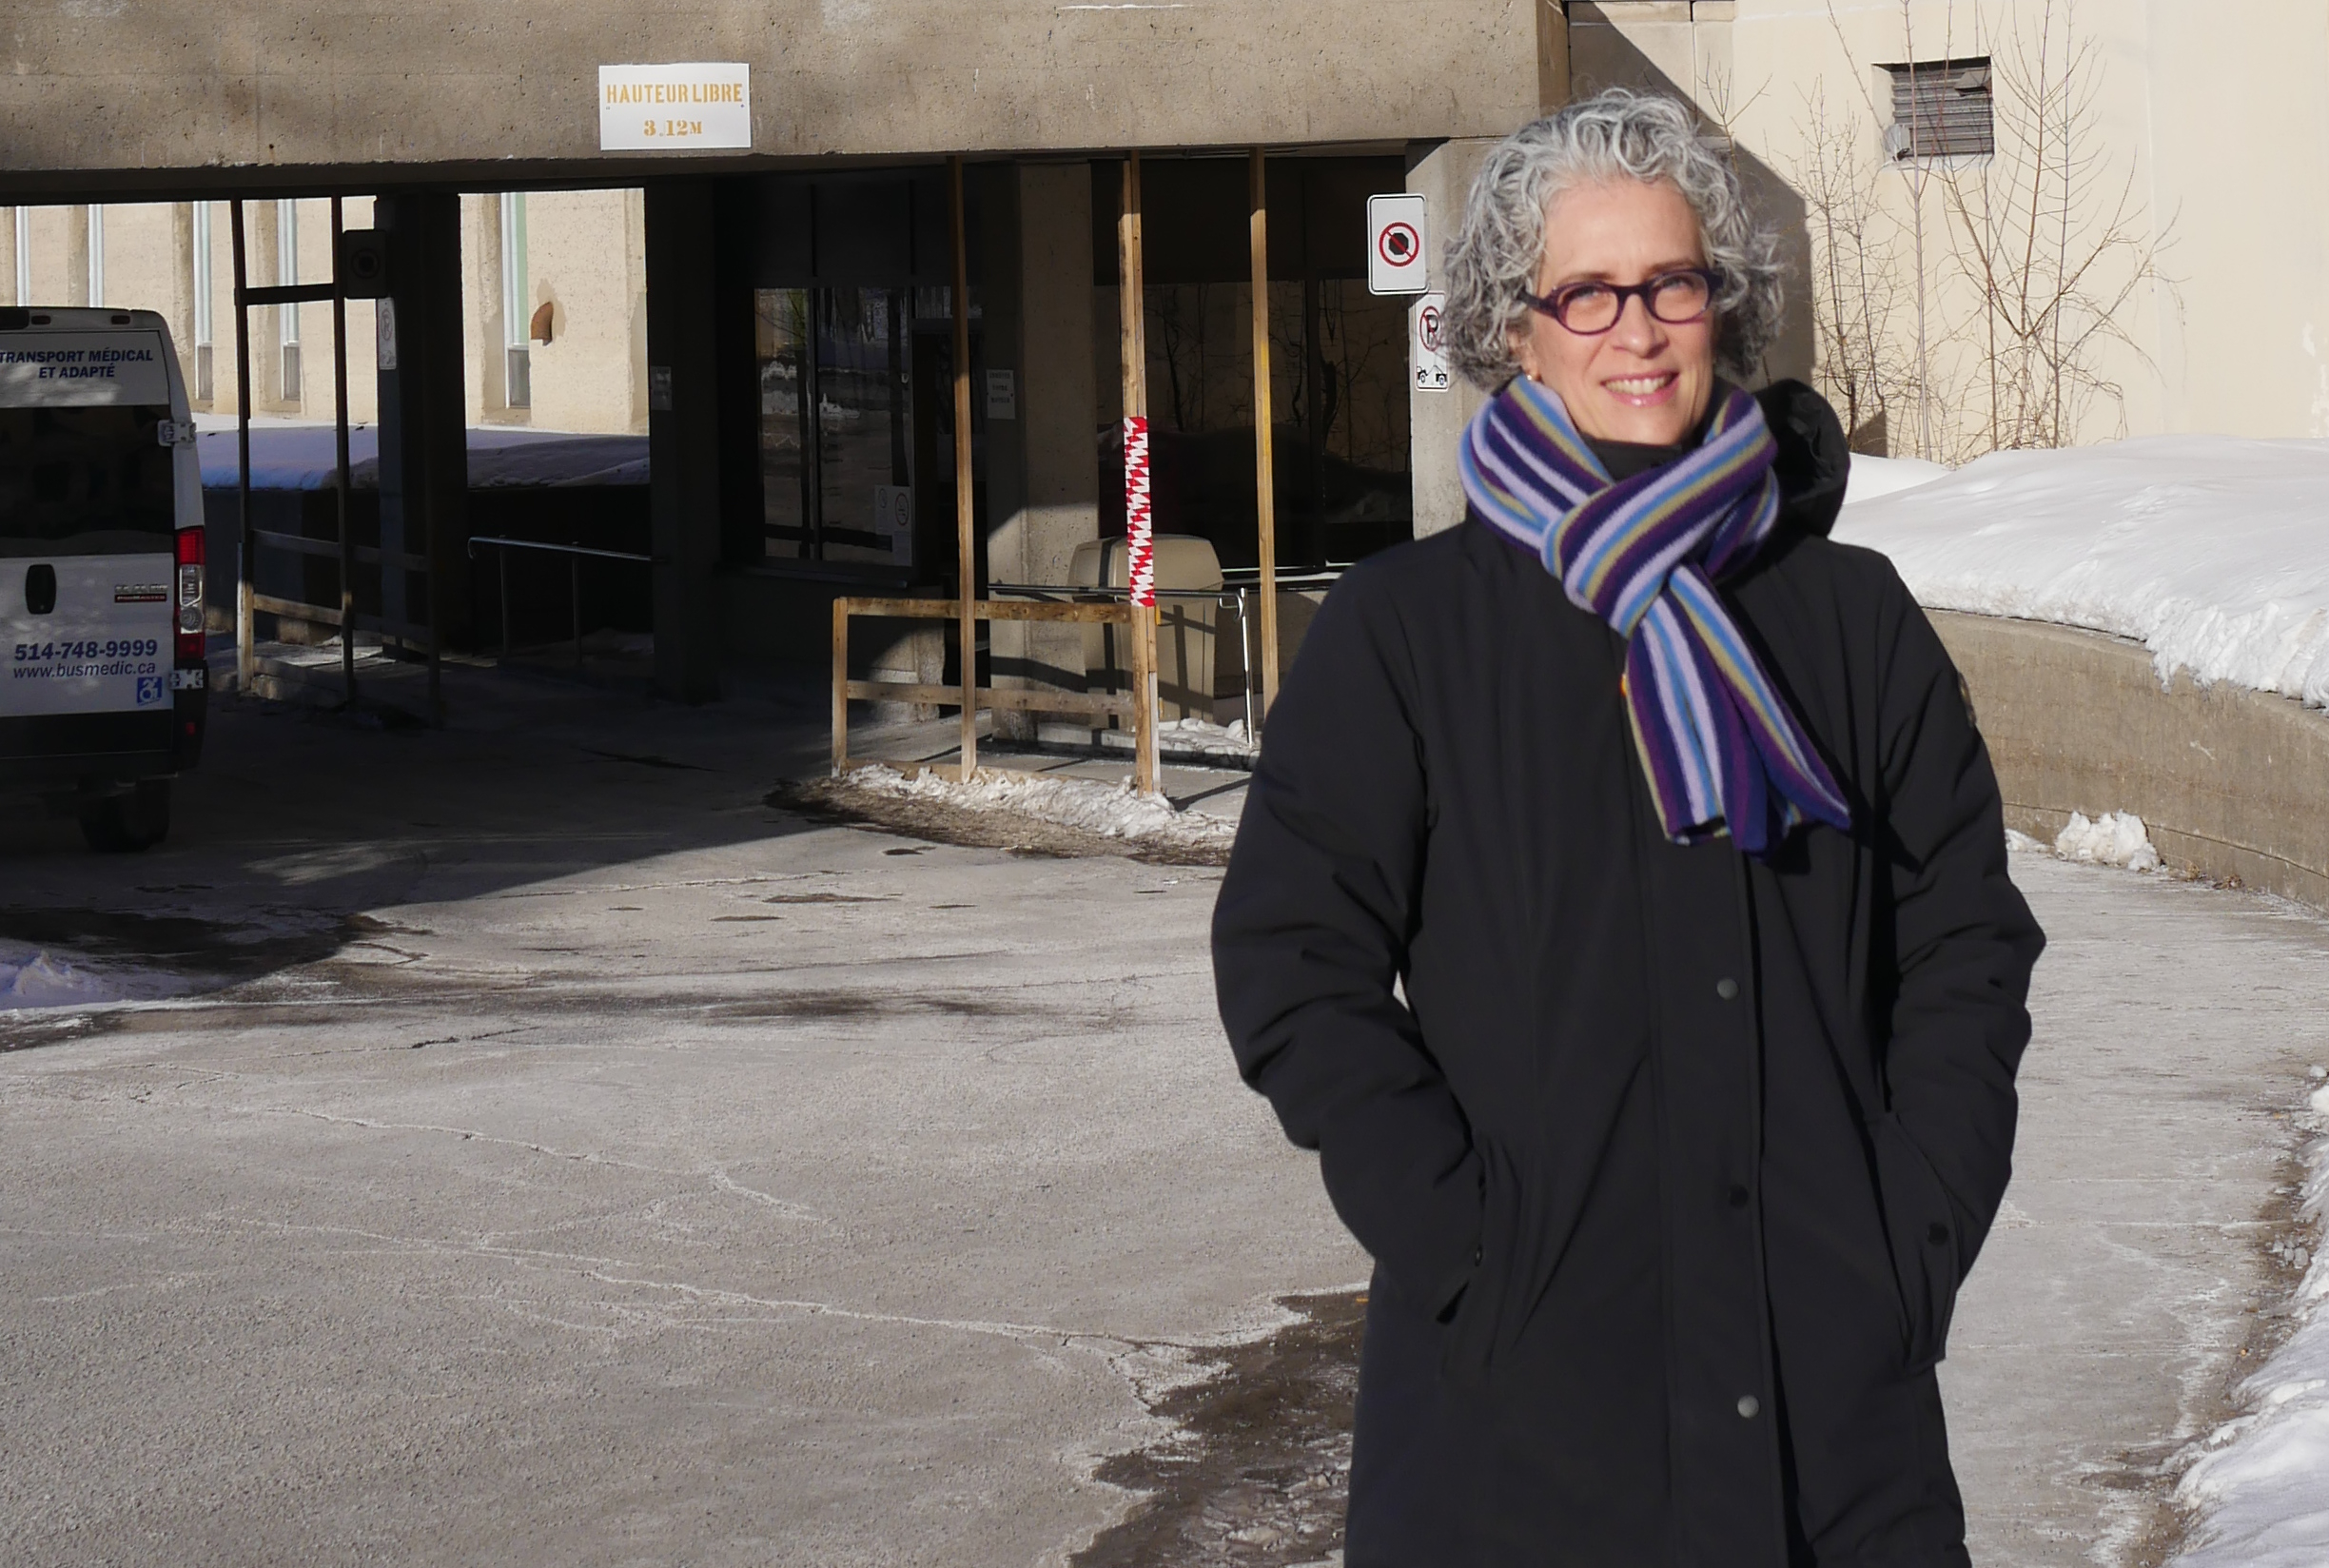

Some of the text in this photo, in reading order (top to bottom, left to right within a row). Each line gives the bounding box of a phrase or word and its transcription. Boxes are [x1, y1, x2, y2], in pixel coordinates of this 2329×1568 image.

[606, 83, 743, 104] HAUTEUR LIBRE
[0, 347, 153, 363] TRANSPORT MÉDICAL
[39, 363, 115, 379] ET ADAPTÉ
[14, 639, 158, 661] 514-748-9999
[13, 662, 156, 678] www.busmedic.ca
